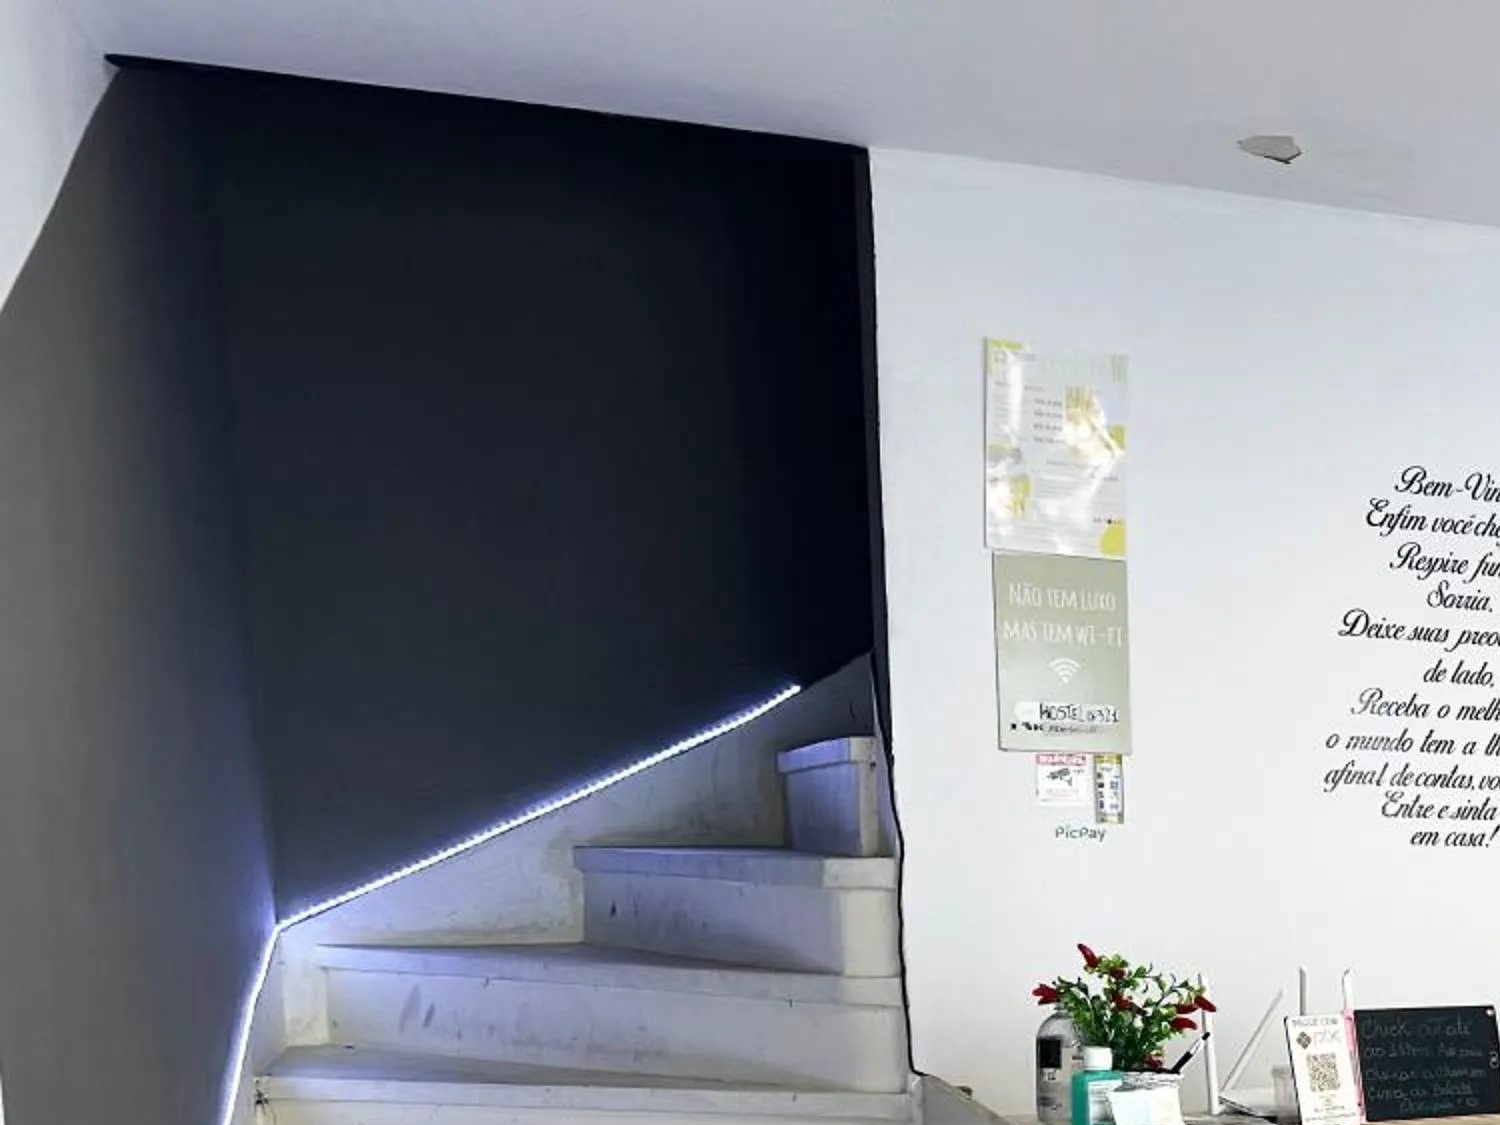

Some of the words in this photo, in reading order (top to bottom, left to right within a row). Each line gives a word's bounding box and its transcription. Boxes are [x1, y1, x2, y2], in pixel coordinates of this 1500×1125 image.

[1366, 498, 1428, 536] Enfim
[1431, 514, 1477, 535] você
[1389, 541, 1469, 580] Respire
[1008, 583, 1042, 606] NÃO
[1046, 587, 1077, 609] TEM
[1081, 590, 1117, 611] LUXO
[1003, 620, 1037, 640] MAS
[1043, 623, 1073, 644] TEM
[1075, 625, 1123, 648] WI-FI
[1338, 608, 1406, 641] Deixe
[1407, 624, 1450, 643] suas
[1423, 658, 1447, 683] de
[1350, 687, 1430, 719] Receba
[1437, 703, 1450, 718] o
[1325, 733, 1340, 750] o
[1345, 728, 1414, 753] mundo
[1420, 729, 1456, 755] tem
[1461, 740, 1478, 755] a
[1323, 759, 1389, 793] afinal
[1390, 763, 1415, 787] de
[1381, 789, 1436, 819] Entre
[1436, 804, 1450, 819] e
[1055, 824, 1106, 842] PicPay
[1410, 830, 1440, 846] em
[1443, 824, 1500, 848] casa!
